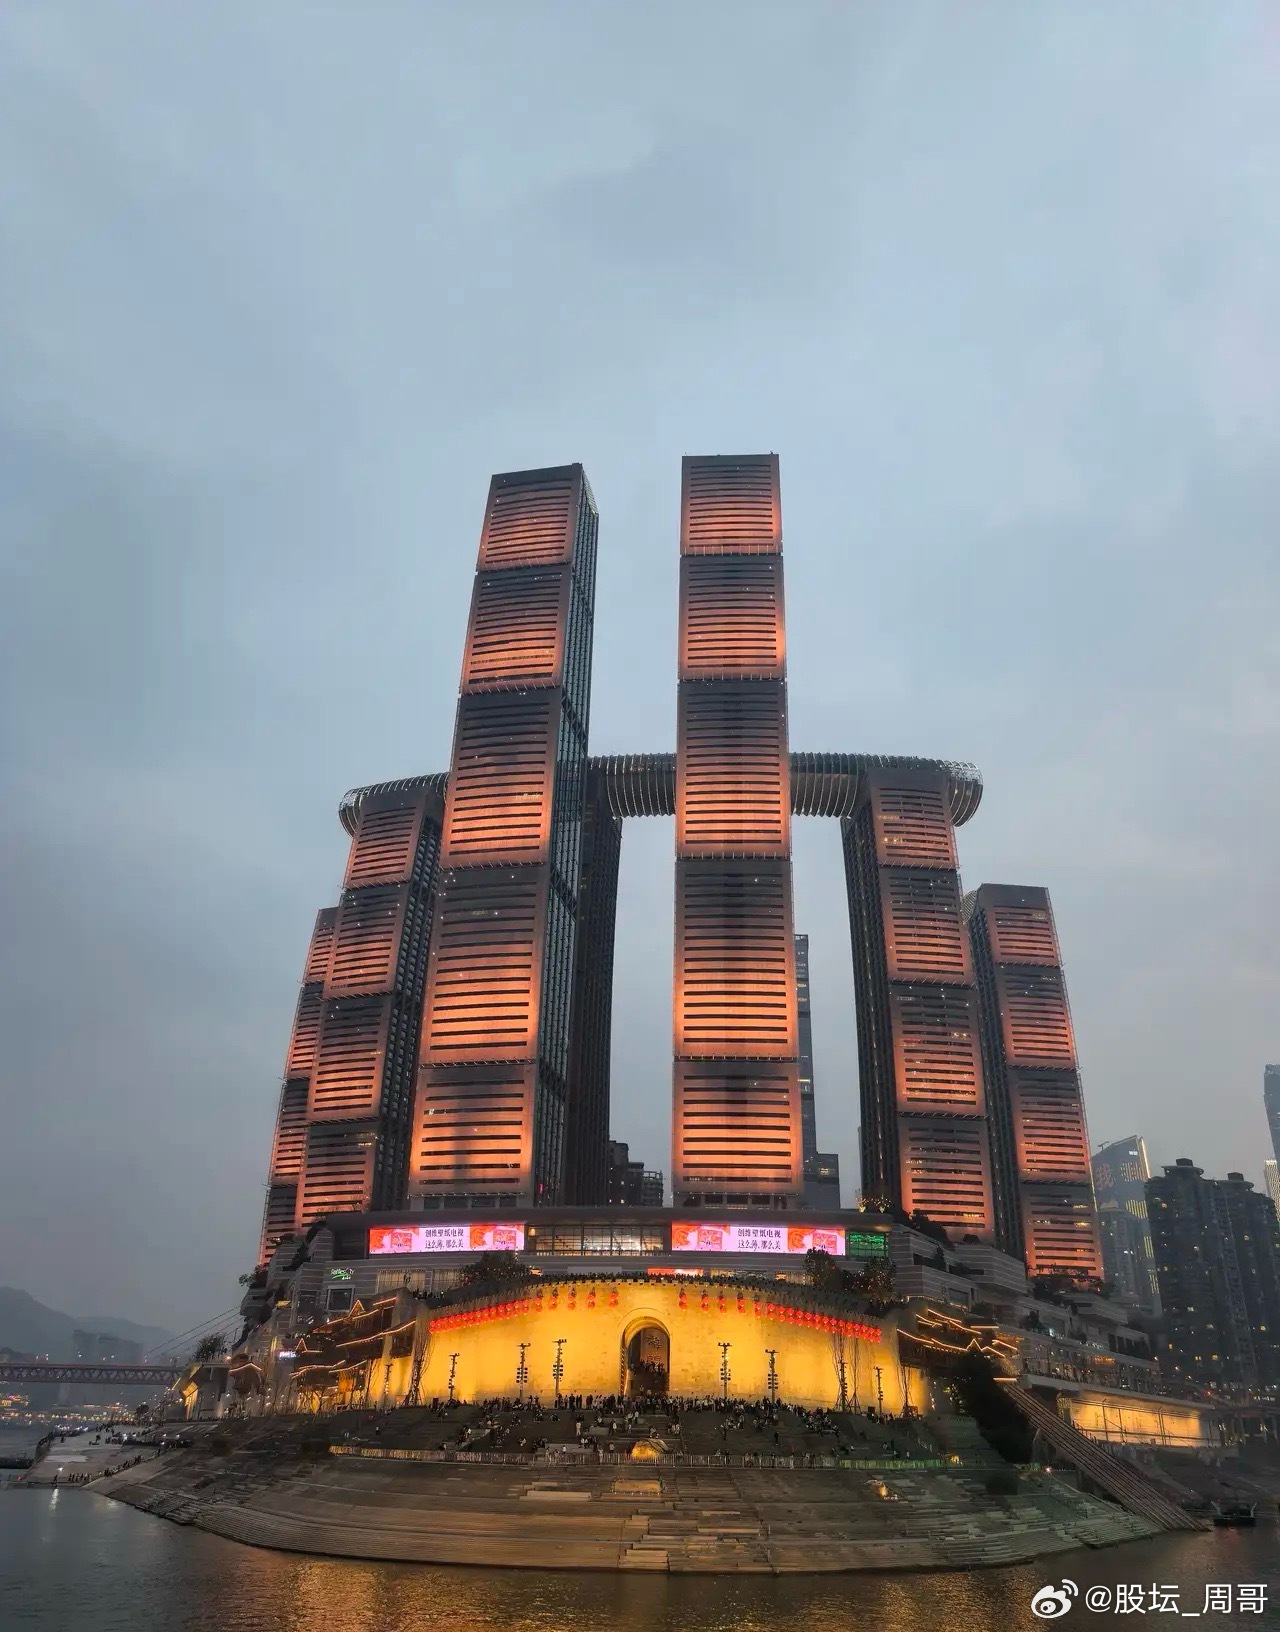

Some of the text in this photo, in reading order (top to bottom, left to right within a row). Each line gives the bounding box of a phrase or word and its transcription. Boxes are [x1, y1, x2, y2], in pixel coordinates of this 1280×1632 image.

[737, 1228, 781, 1238] 创维壁纸电视
